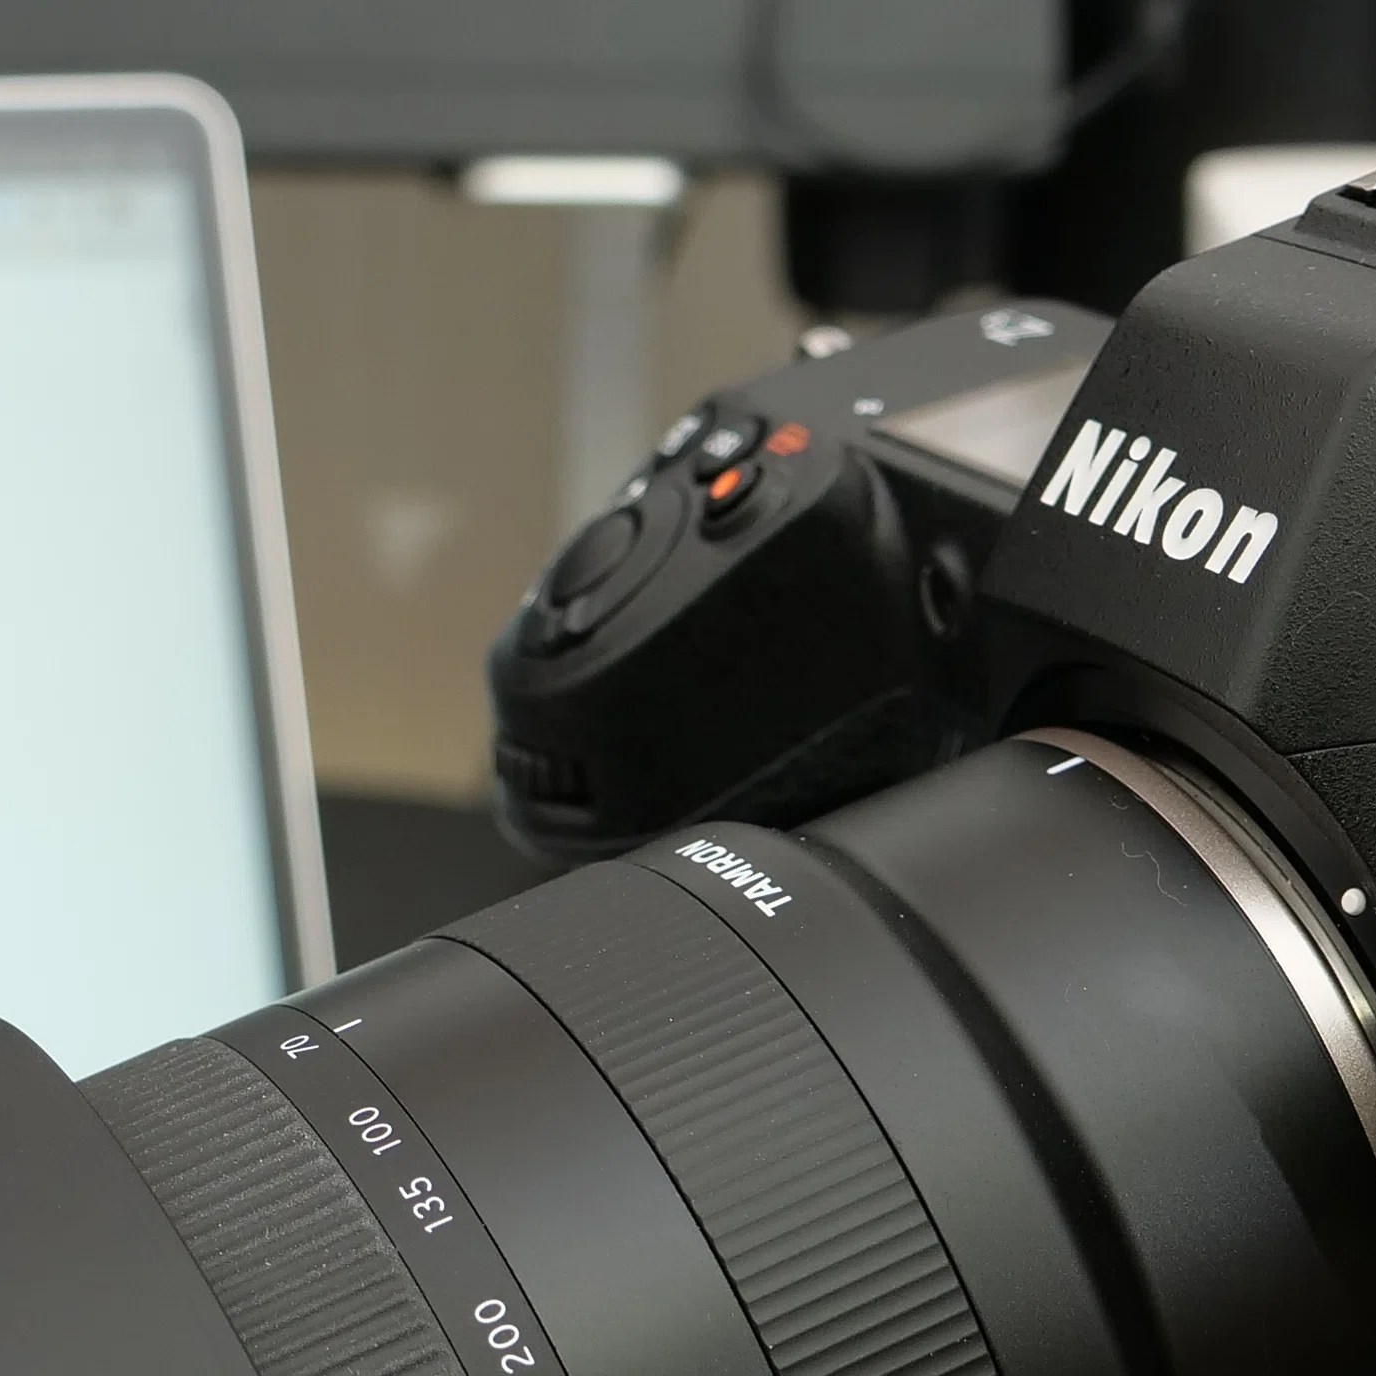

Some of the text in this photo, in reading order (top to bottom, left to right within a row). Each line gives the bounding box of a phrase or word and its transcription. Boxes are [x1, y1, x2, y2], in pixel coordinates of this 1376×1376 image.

[1038, 417, 1279, 584] Nikon
[675, 839, 792, 917] TAMRON
[279, 1034, 320, 1060] 70
[348, 1106, 402, 1156] 100
[398, 1176, 454, 1234] 135
[474, 1299, 536, 1374] 200
